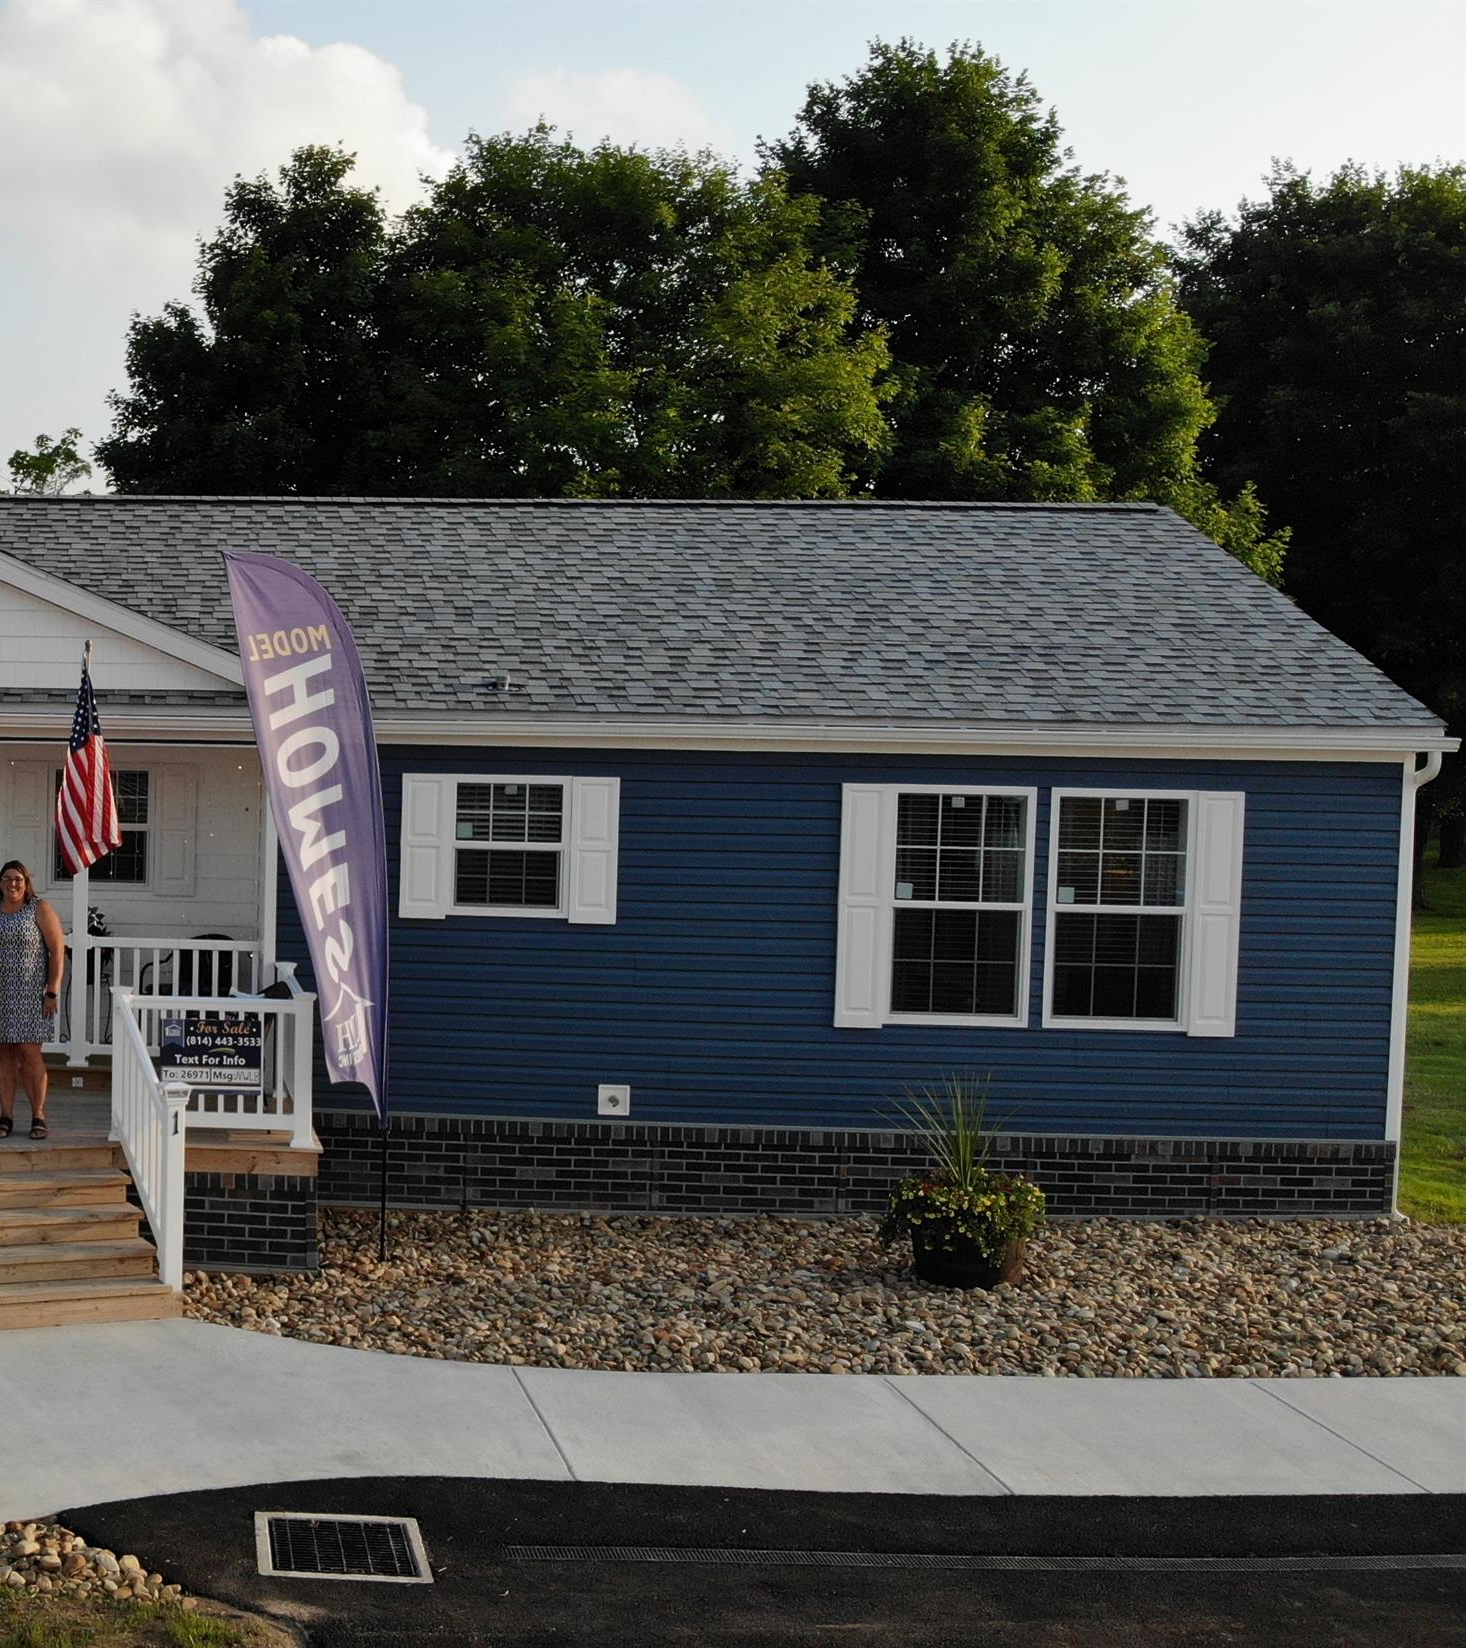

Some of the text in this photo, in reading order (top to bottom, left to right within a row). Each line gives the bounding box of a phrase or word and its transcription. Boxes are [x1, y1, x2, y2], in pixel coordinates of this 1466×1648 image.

[196, 1021, 218, 1034] For
[221, 1021, 252, 1034] Sale
[186, 1036, 262, 1047] (814) 443-3533
[174, 1054, 246, 1066] Text For Info
[163, 1070, 178, 1079] To:
[181, 1070, 209, 1079] 26971
[172, 1110, 179, 1136] 1
